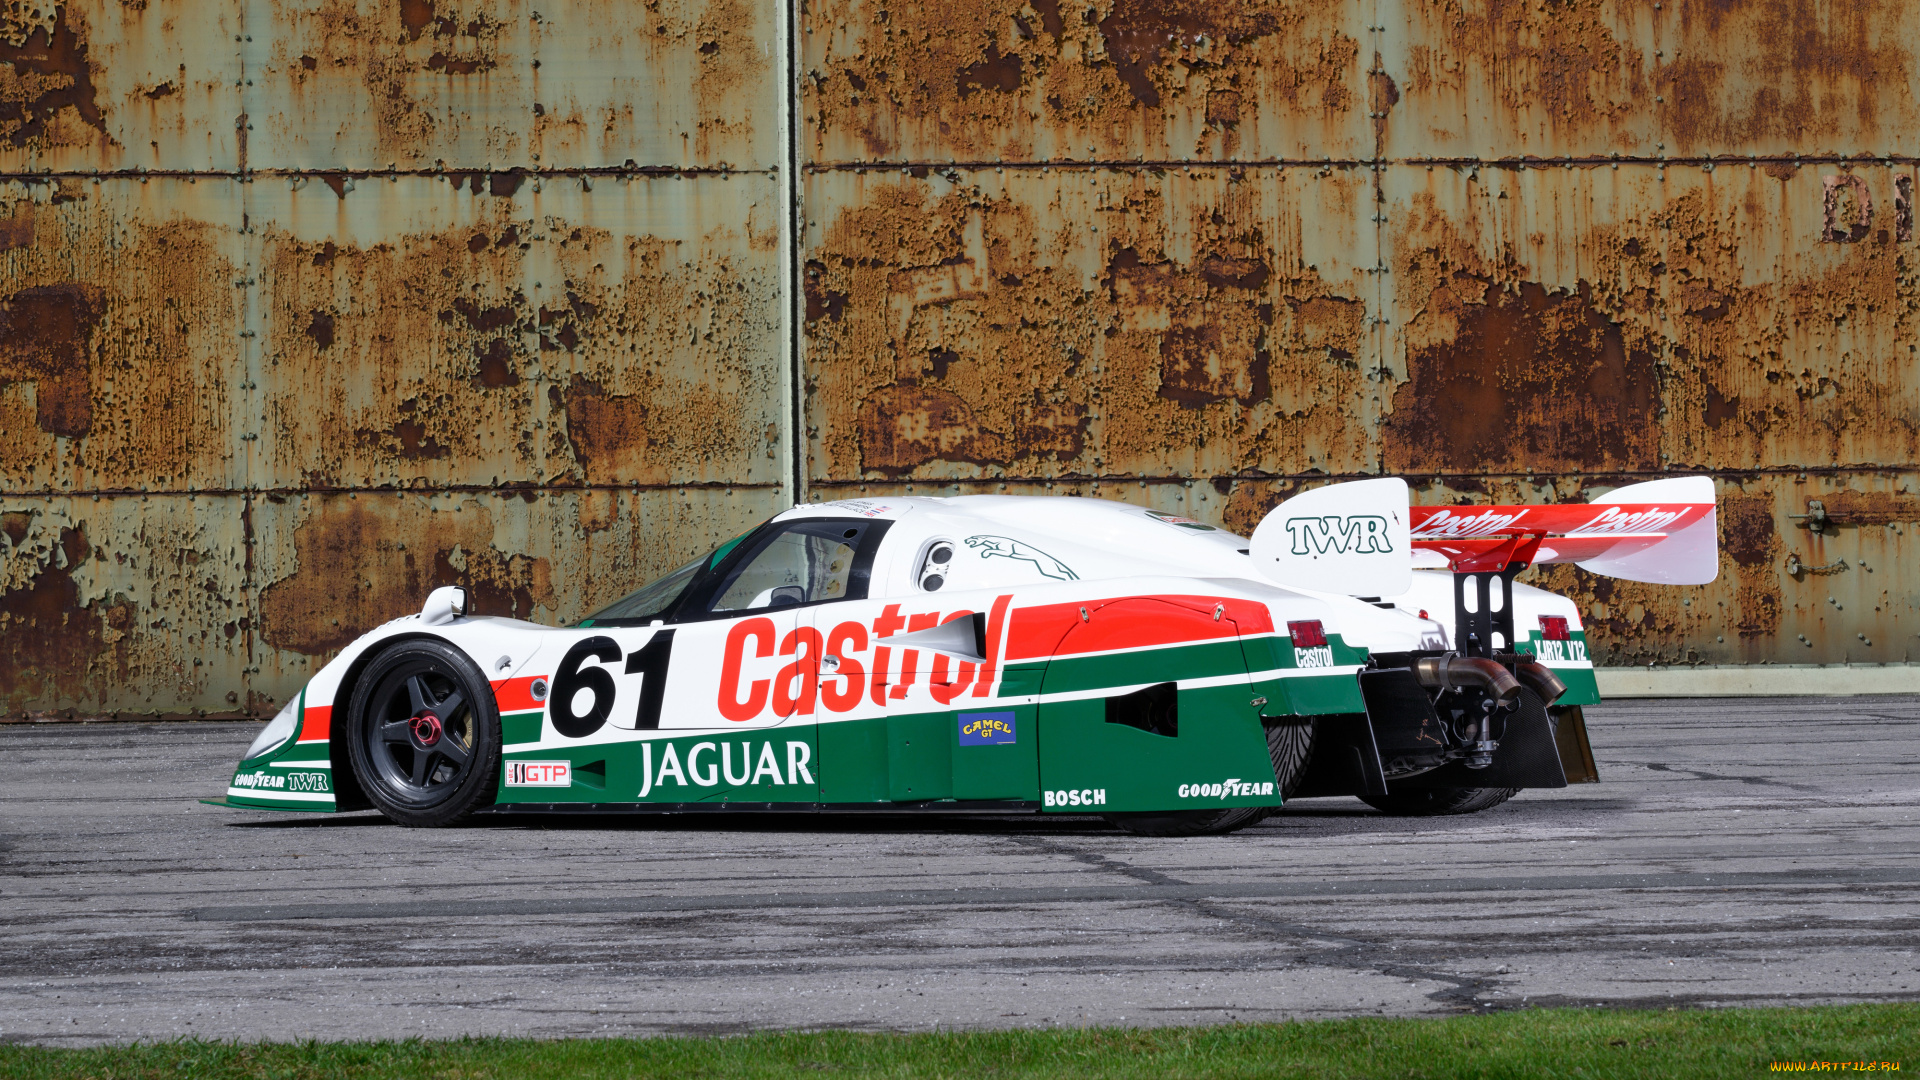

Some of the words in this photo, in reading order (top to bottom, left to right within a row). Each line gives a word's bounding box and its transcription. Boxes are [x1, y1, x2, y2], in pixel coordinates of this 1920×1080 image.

[1411, 508, 1530, 535] Castrol
[1567, 506, 1692, 534] Castrol
[1286, 515, 1392, 554] TWR
[717, 594, 1014, 722] Castrol
[1294, 645, 1334, 668] Castrol
[1533, 640, 1565, 661] XJR12
[1566, 640, 1588, 661] V12
[549, 628, 677, 738] 61
[962, 719, 1012, 735] CAMEL
[981, 728, 993, 738] GT
[526, 765, 567, 782] GTP
[637, 741, 815, 798] JAGUAR
[288, 772, 329, 791] TWR
[1044, 788, 1106, 807] BOSCH
